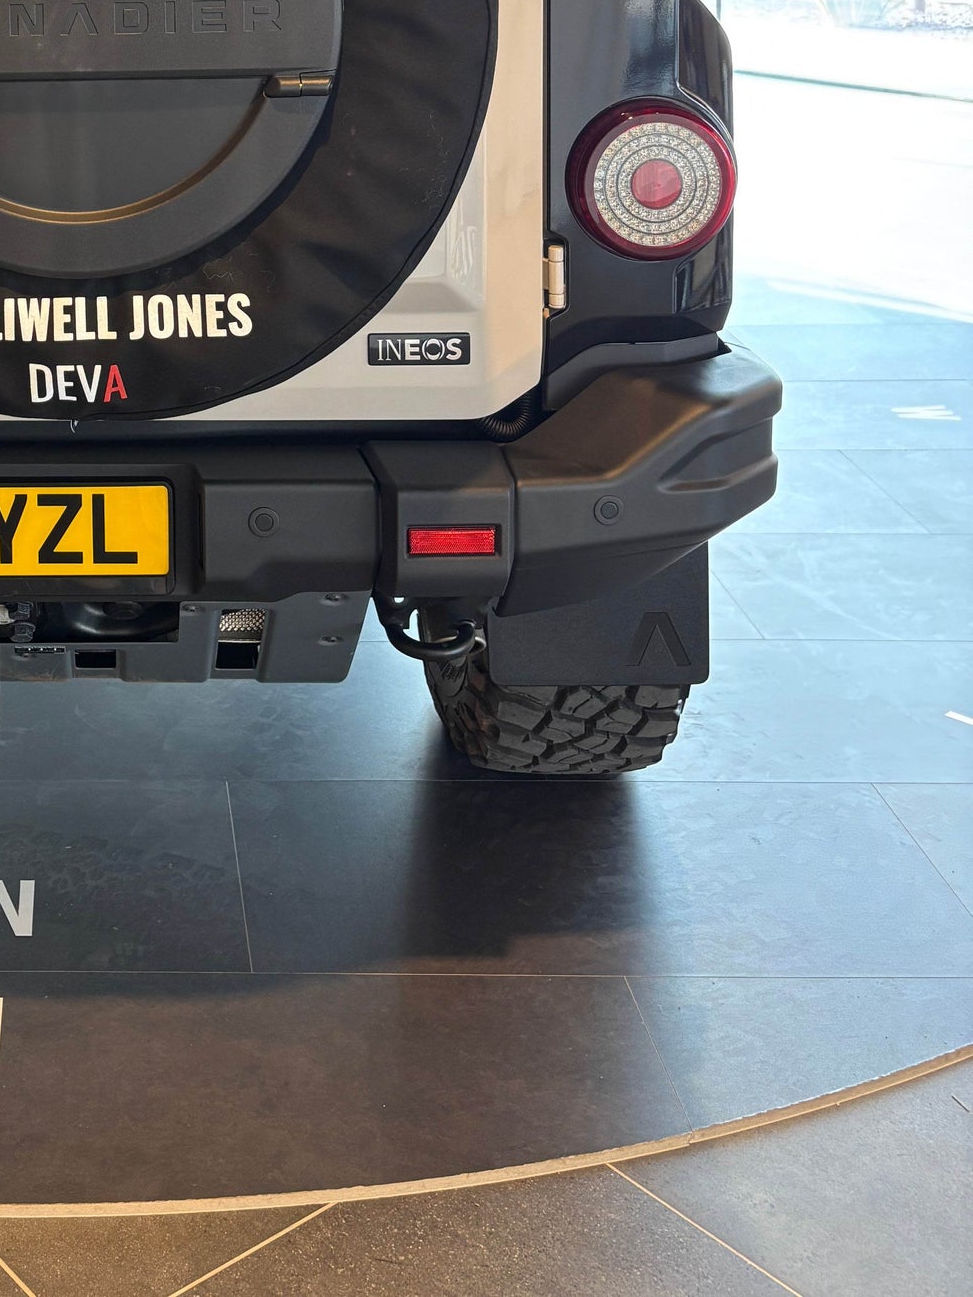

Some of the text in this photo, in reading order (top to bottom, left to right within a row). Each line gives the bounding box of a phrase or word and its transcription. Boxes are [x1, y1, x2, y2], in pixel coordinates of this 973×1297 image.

[129, 292, 253, 340] JONES
[377, 338, 462, 361] INEOS
[28, 363, 128, 403] DEVA
